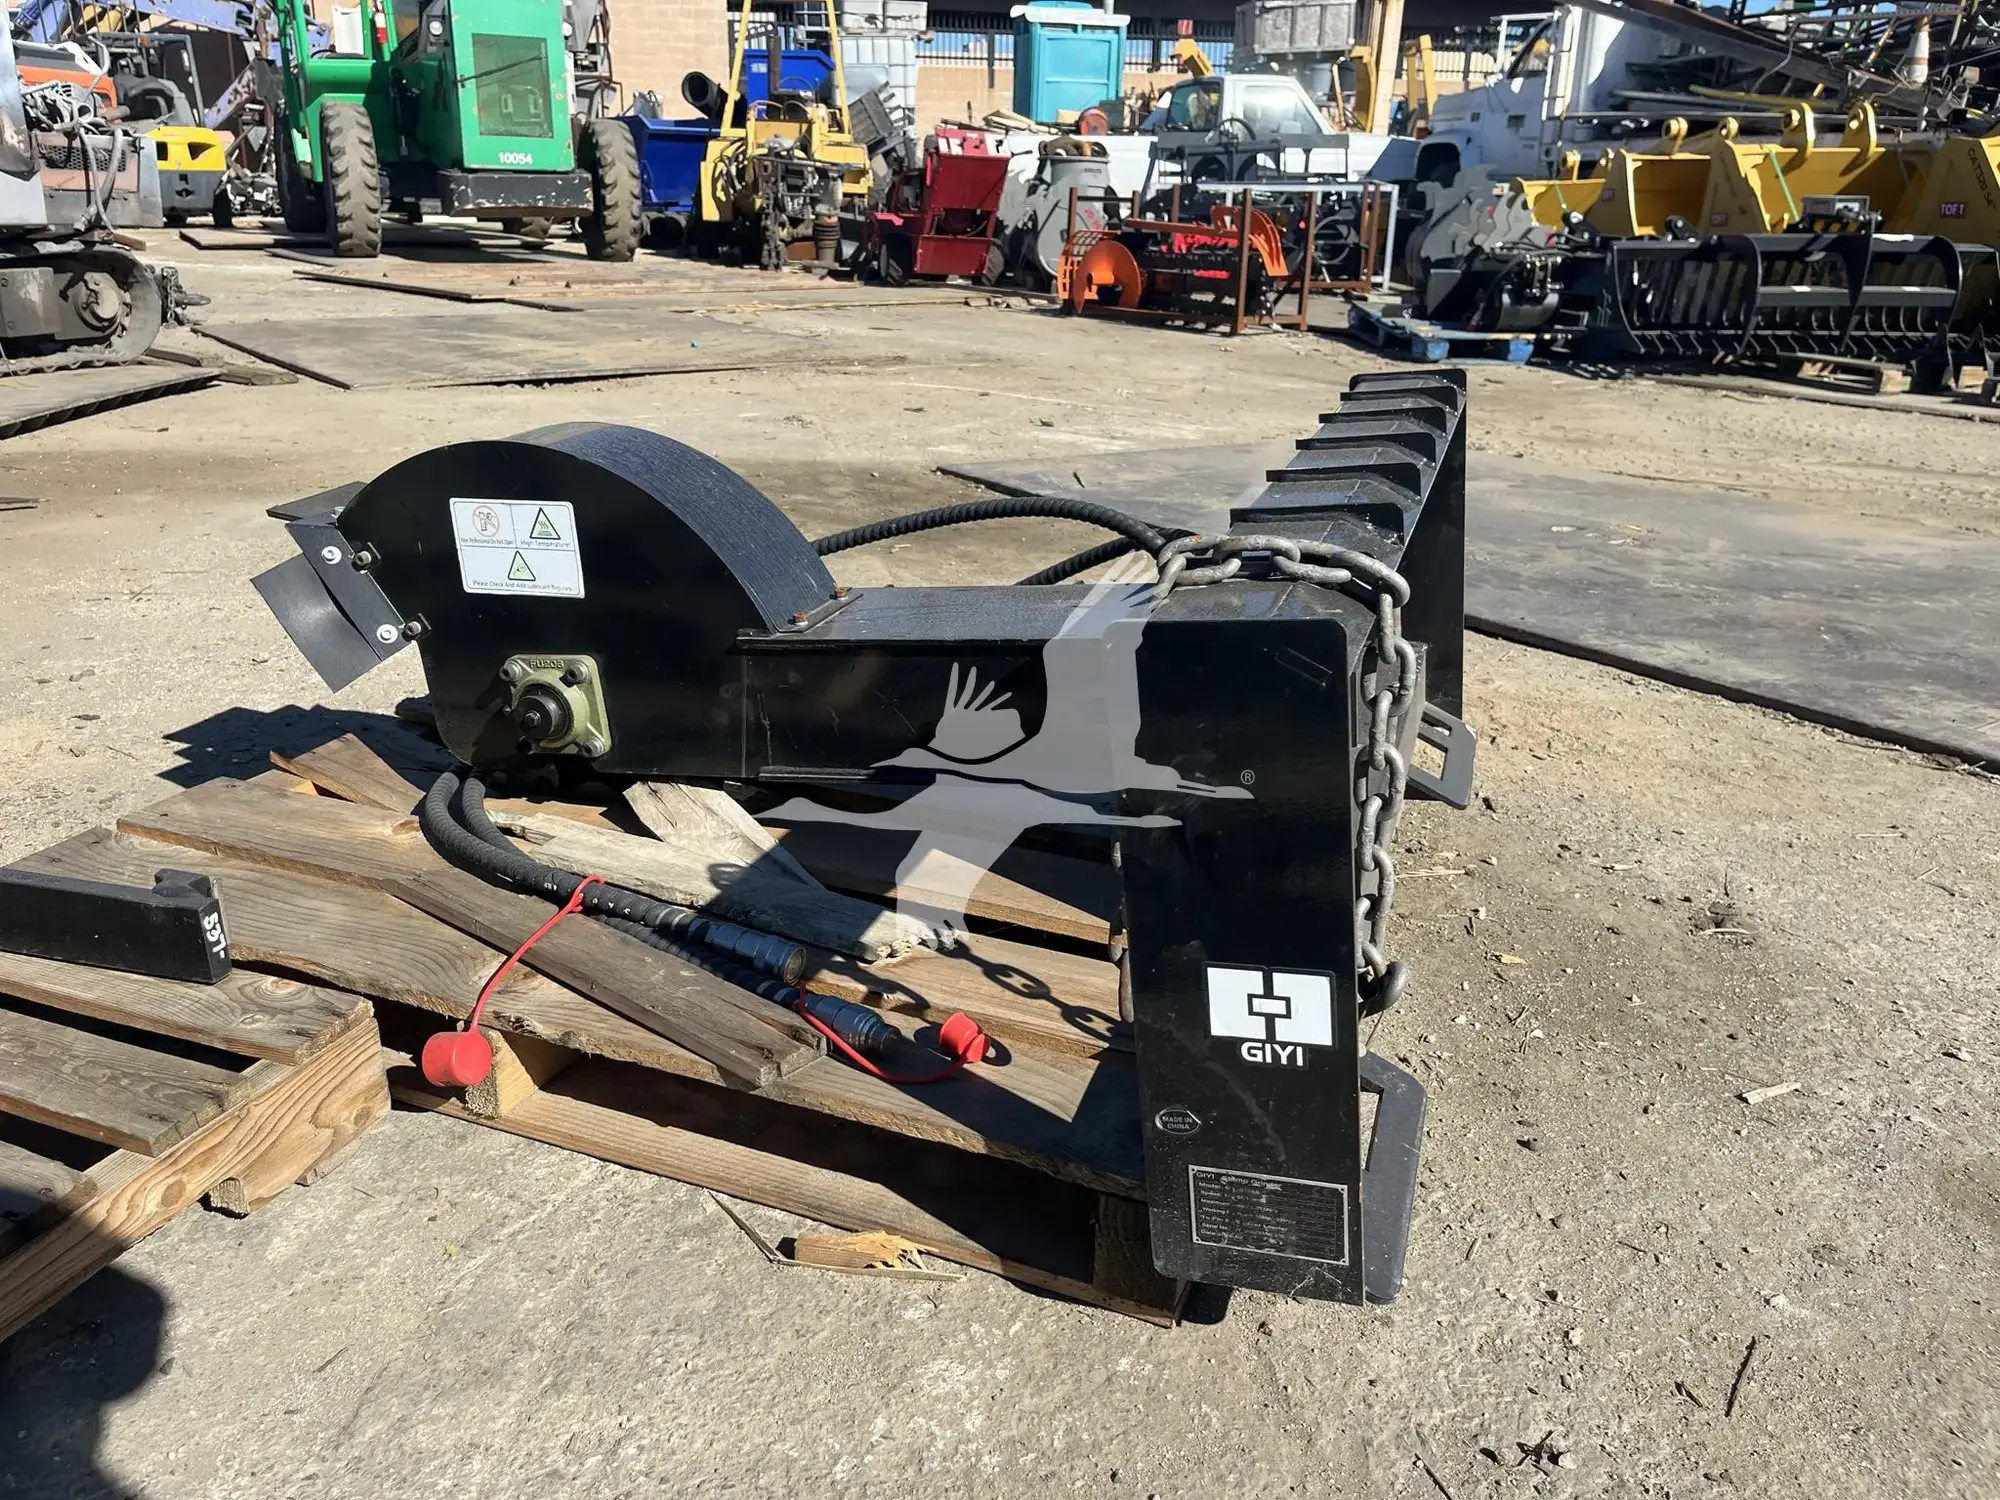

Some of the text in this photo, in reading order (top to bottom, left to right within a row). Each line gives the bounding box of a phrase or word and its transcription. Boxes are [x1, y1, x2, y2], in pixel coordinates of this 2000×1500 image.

[498, 151, 534, 165] 10054
[1940, 203, 1965, 215] TOFT
[520, 540, 533, 548] High
[473, 579, 489, 587] Please
[527, 582, 550, 590] Lubricant
[1240, 1041, 1304, 1067] GIYI
[1196, 1171, 1215, 1180] GIYI
